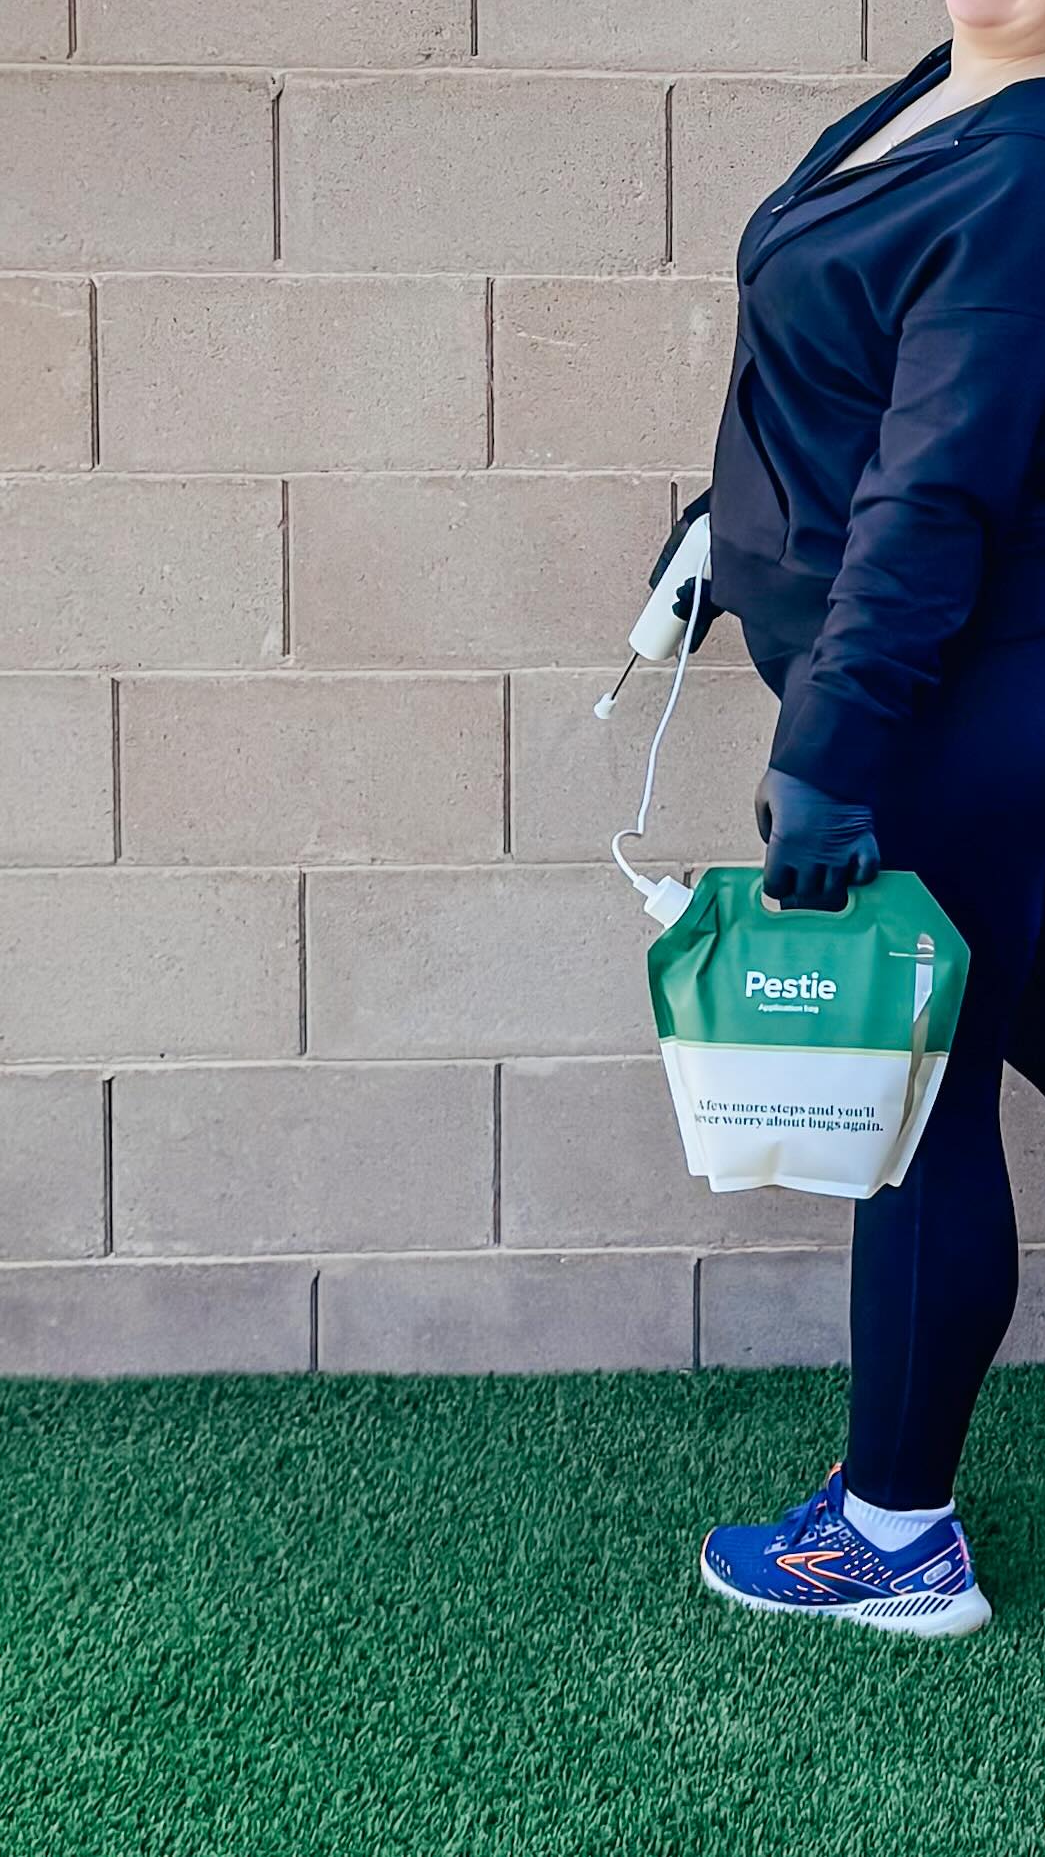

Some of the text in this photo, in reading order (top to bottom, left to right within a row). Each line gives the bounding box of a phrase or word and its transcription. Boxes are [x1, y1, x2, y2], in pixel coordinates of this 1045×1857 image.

[745, 970, 837, 1000] Pestie
[706, 1099, 730, 1111] few
[732, 1103, 768, 1113] more
[769, 1104, 806, 1117] steps
[808, 1105, 834, 1116] and
[838, 1106, 875, 1119] you'll
[722, 1116, 763, 1129] worry
[766, 1116, 805, 1128] about
[808, 1117, 841, 1131] bugs
[842, 1120, 884, 1132] again.
